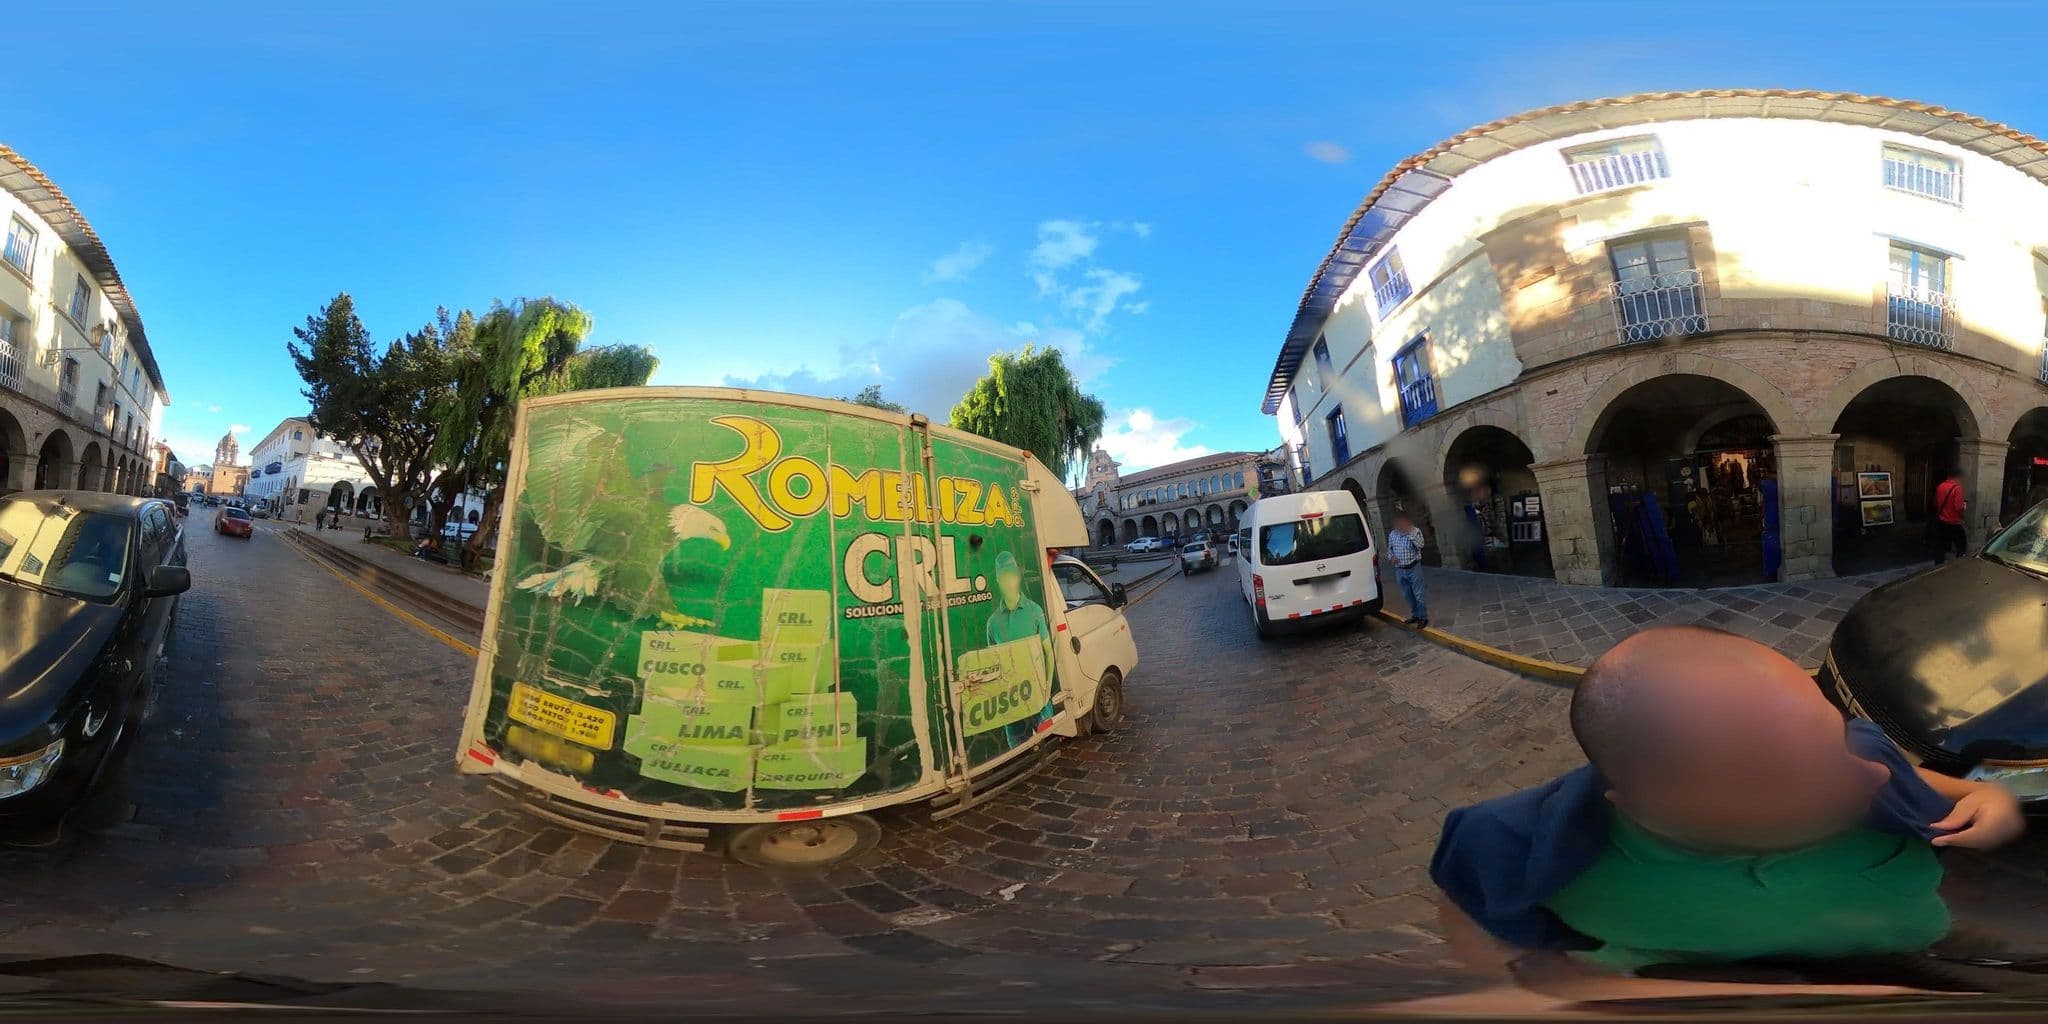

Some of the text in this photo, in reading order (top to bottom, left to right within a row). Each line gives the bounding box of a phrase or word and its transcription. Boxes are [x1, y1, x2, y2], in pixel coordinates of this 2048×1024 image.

[690, 415, 1013, 532] ROMELIZA
[843, 531, 987, 603] CRL.
[845, 604, 904, 619] SOLUCION
[967, 592, 993, 604] CARGO
[777, 612, 813, 624] CRL.
[649, 640, 675, 651] CRL.
[780, 652, 807, 662] CRL.
[643, 660, 706, 676] CUSCO
[717, 680, 745, 689] CRL.
[970, 679, 1032, 727] CUSCO
[678, 724, 744, 739] LIMA
[648, 759, 730, 777] JULIACA
